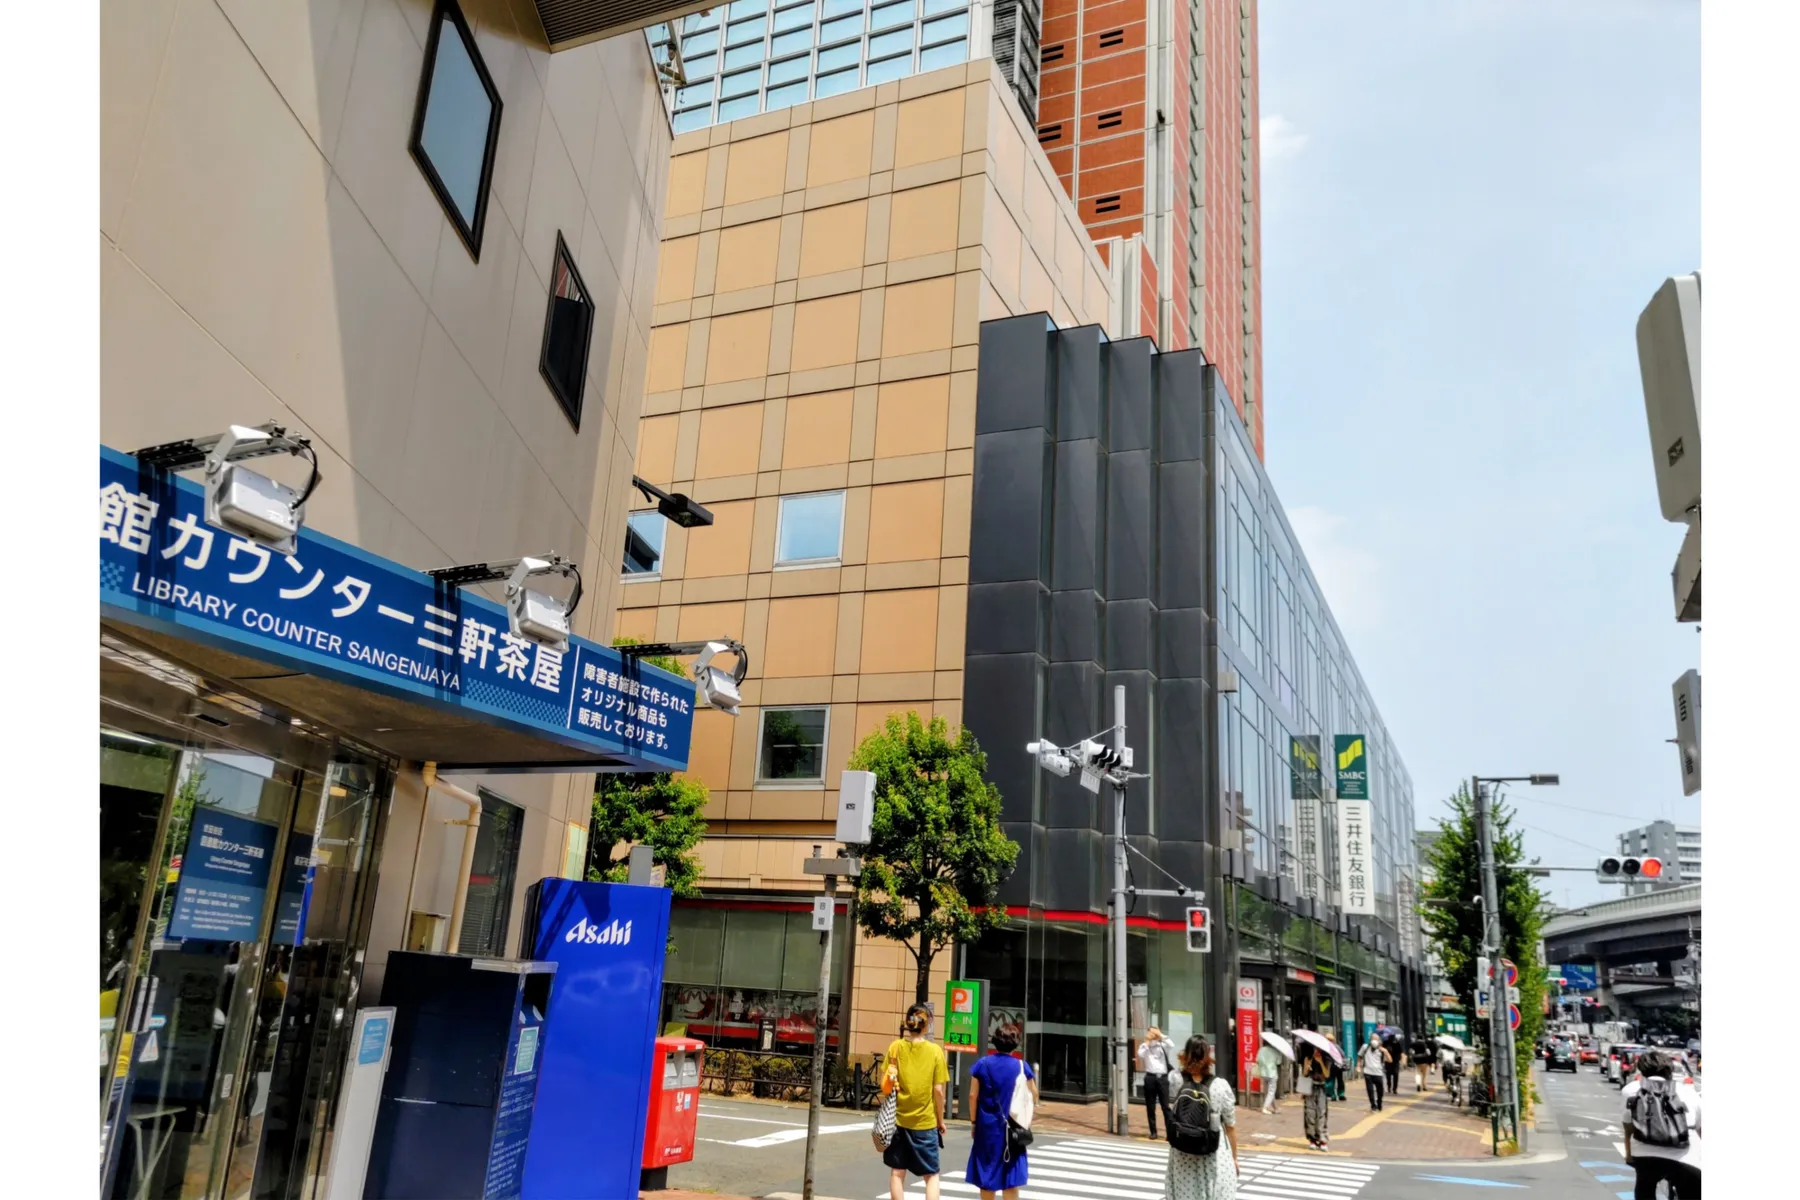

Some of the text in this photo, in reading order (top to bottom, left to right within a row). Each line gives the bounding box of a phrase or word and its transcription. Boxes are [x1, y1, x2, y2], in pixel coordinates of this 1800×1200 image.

[100, 481, 563, 693] 館カウンター三軒茶屋
[132, 572, 460, 690] LIBRARY COUNTER SANGENJAYA
[581, 686, 668, 728] オリジナル商品も
[583, 662, 689, 715] 障害者施設で作られた
[577, 706, 668, 750] 販売しております。
[1338, 771, 1366, 780] SMBC
[1345, 805, 1366, 908] 三井住友銀行
[565, 916, 632, 946] Asahi
[962, 1016, 973, 1025] IN
